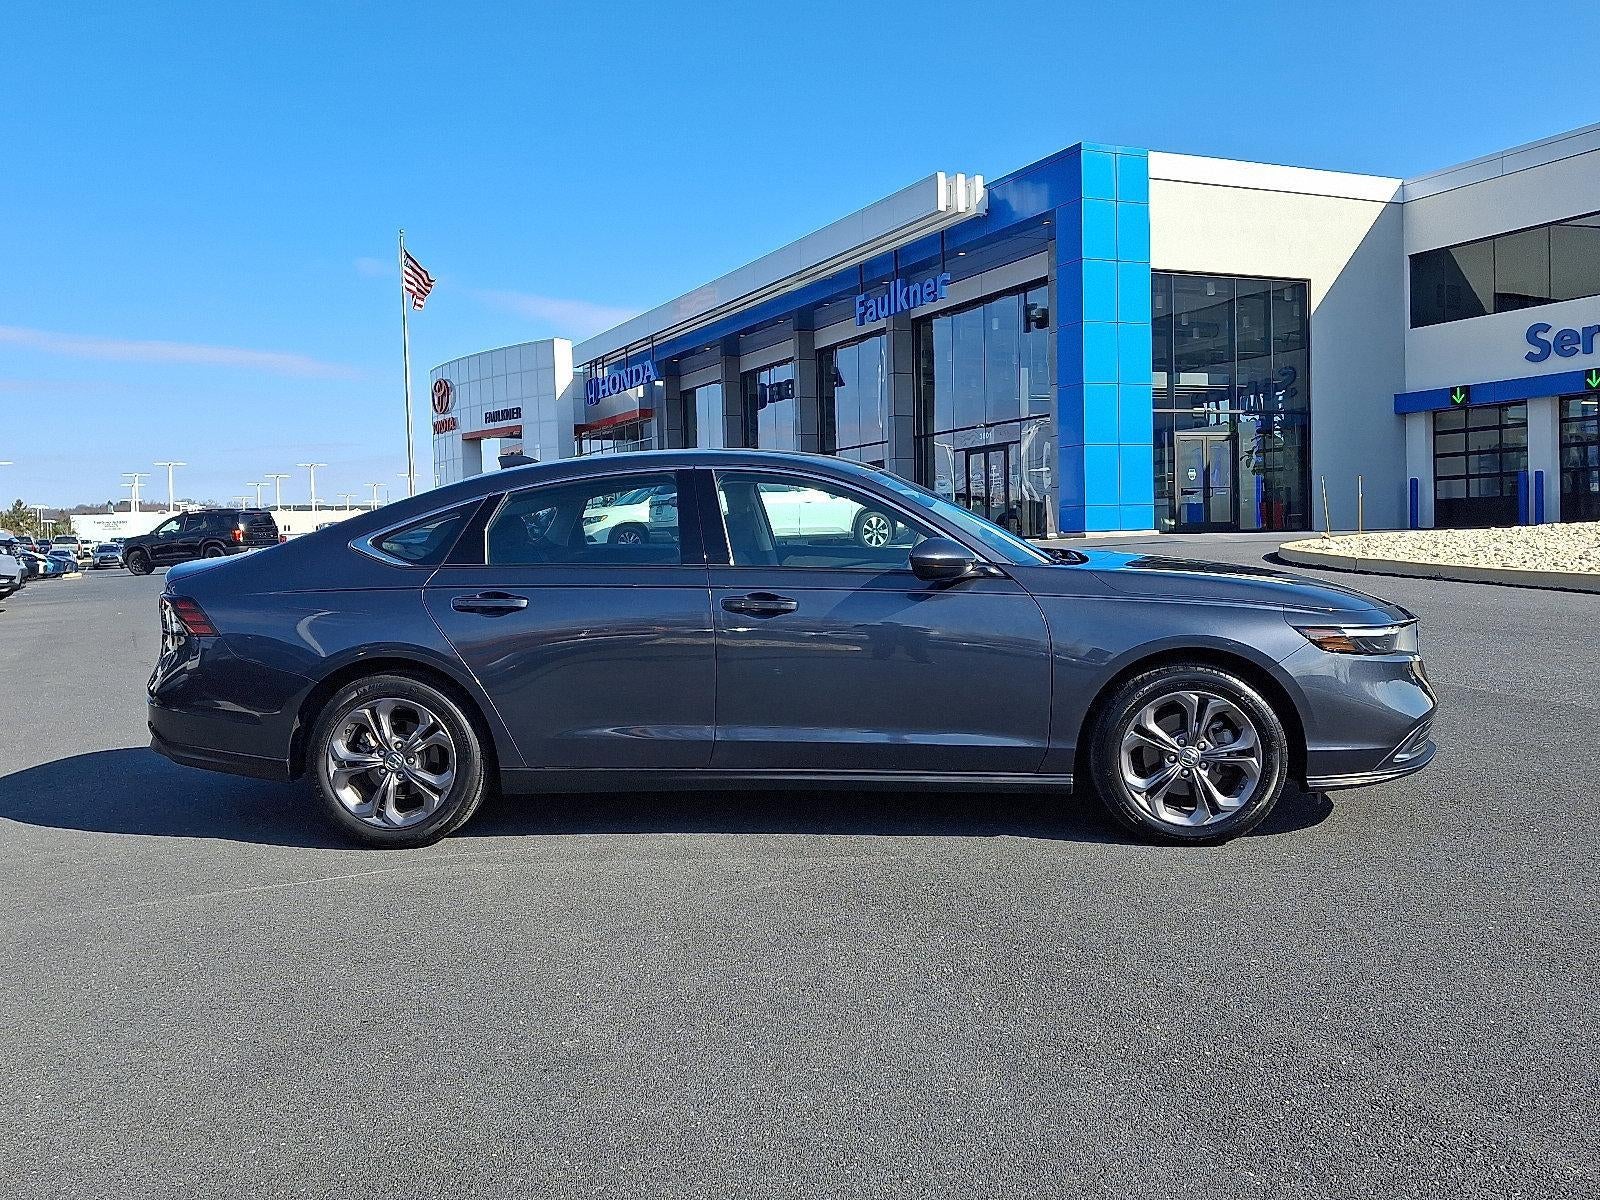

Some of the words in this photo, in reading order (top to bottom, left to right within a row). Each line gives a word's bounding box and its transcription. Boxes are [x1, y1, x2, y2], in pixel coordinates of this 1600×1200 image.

[855, 272, 951, 326] Faulkner
[597, 360, 658, 399] HONDA
[432, 416, 458, 436] TOYOTA
[484, 406, 522, 424] FAULKNER
